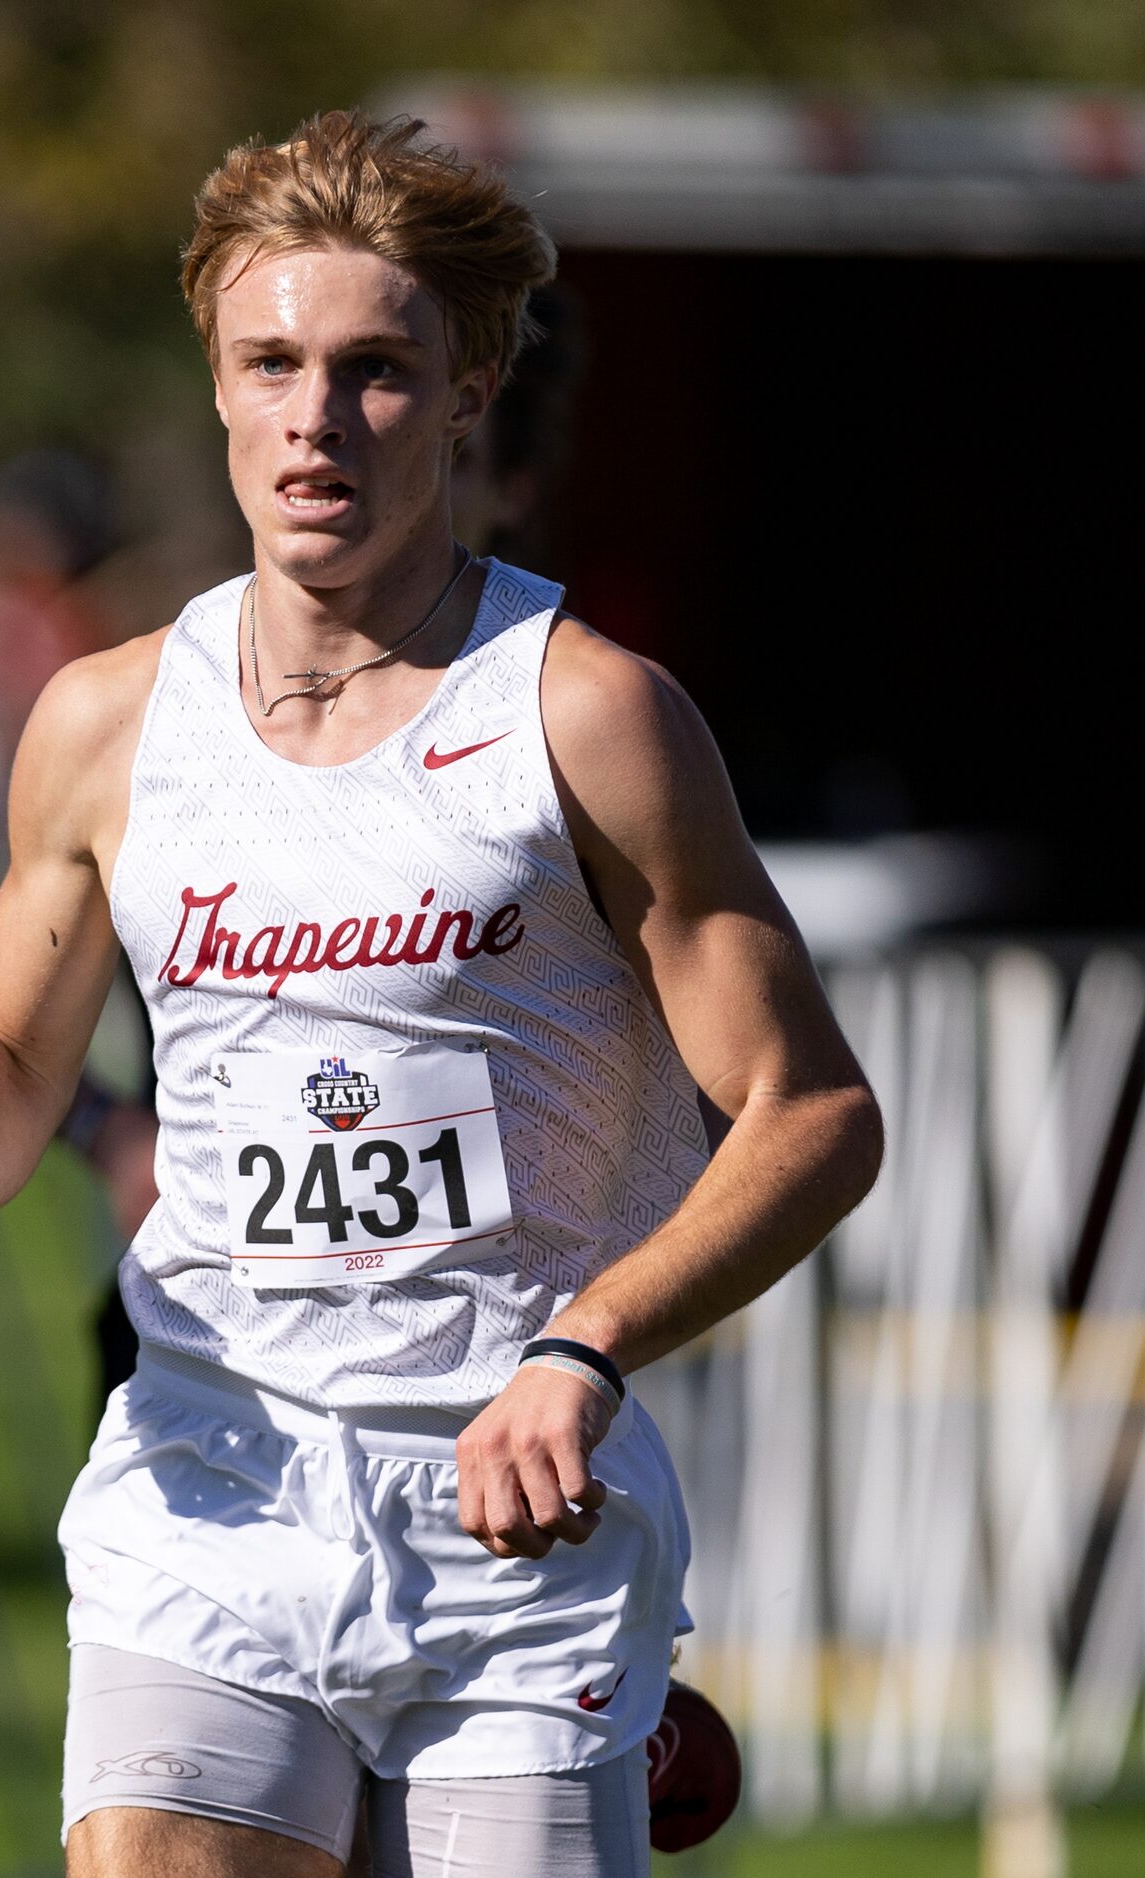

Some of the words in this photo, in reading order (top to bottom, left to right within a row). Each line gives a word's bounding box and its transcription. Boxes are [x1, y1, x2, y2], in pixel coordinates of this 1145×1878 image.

[158, 882, 525, 999] Grapevine
[302, 1086, 379, 1108] STATE
[238, 1127, 472, 1244] 2431
[344, 1254, 385, 1272] 2022
